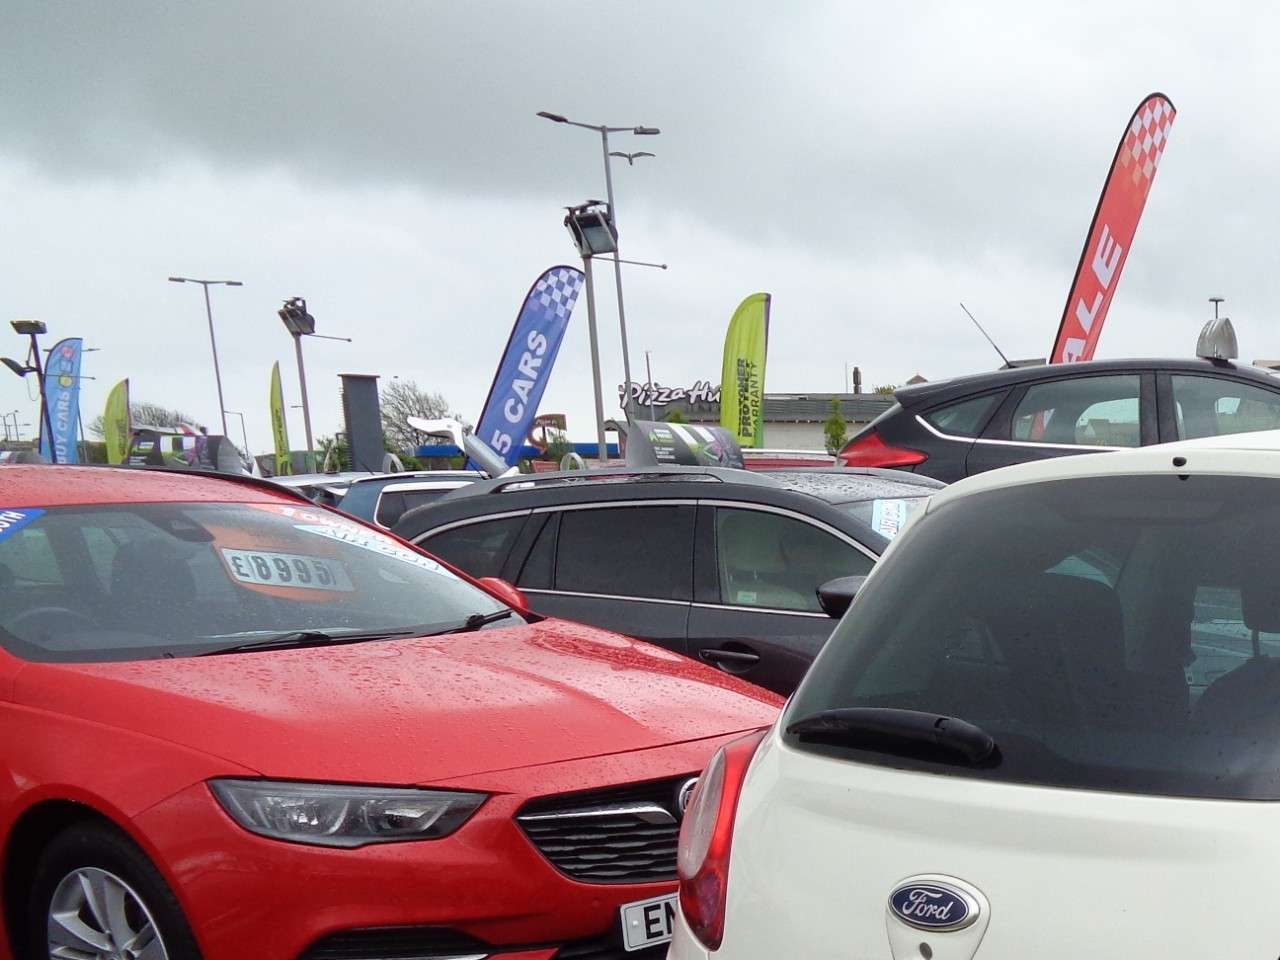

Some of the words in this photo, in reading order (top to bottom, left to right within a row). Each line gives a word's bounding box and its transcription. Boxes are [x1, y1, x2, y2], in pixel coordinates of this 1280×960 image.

[1062, 223, 1122, 363] ALE
[504, 330, 547, 424] CARS
[619, 381, 686, 409] Pizza
[685, 379, 721, 404] Hu
[231, 556, 334, 586] £8995
[902, 889, 955, 920] Ford
